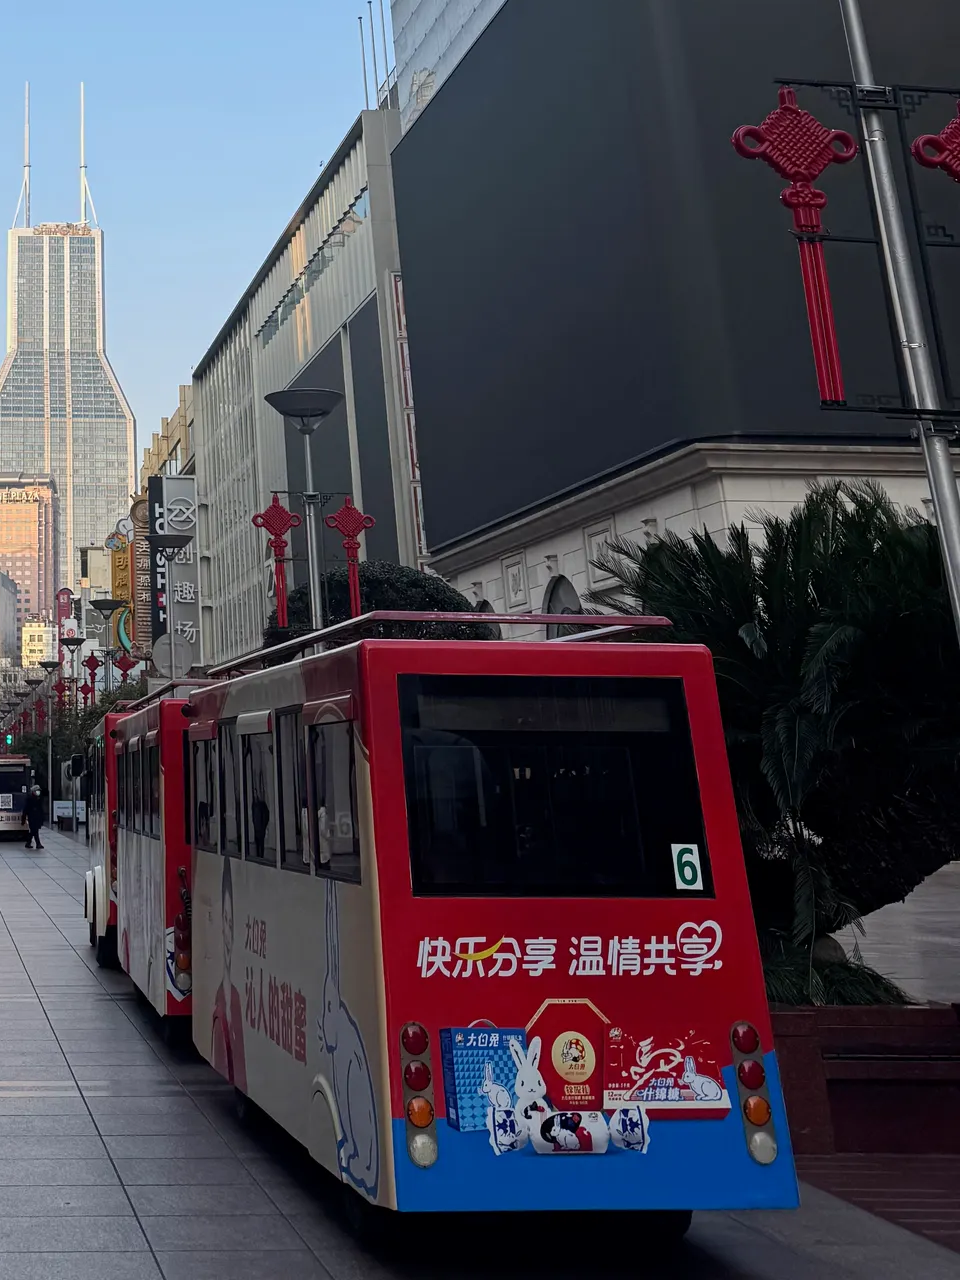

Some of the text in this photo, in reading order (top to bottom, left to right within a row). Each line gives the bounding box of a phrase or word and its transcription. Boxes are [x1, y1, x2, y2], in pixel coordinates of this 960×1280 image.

[11, 491, 39, 501] PLAZA
[155, 503, 166, 589] TISOT
[676, 847, 698, 886] 6
[416, 920, 723, 979] 快乐分享 温情共享
[244, 966, 308, 1067] 沁人的甜蜜
[466, 1032, 500, 1047] 大白兔
